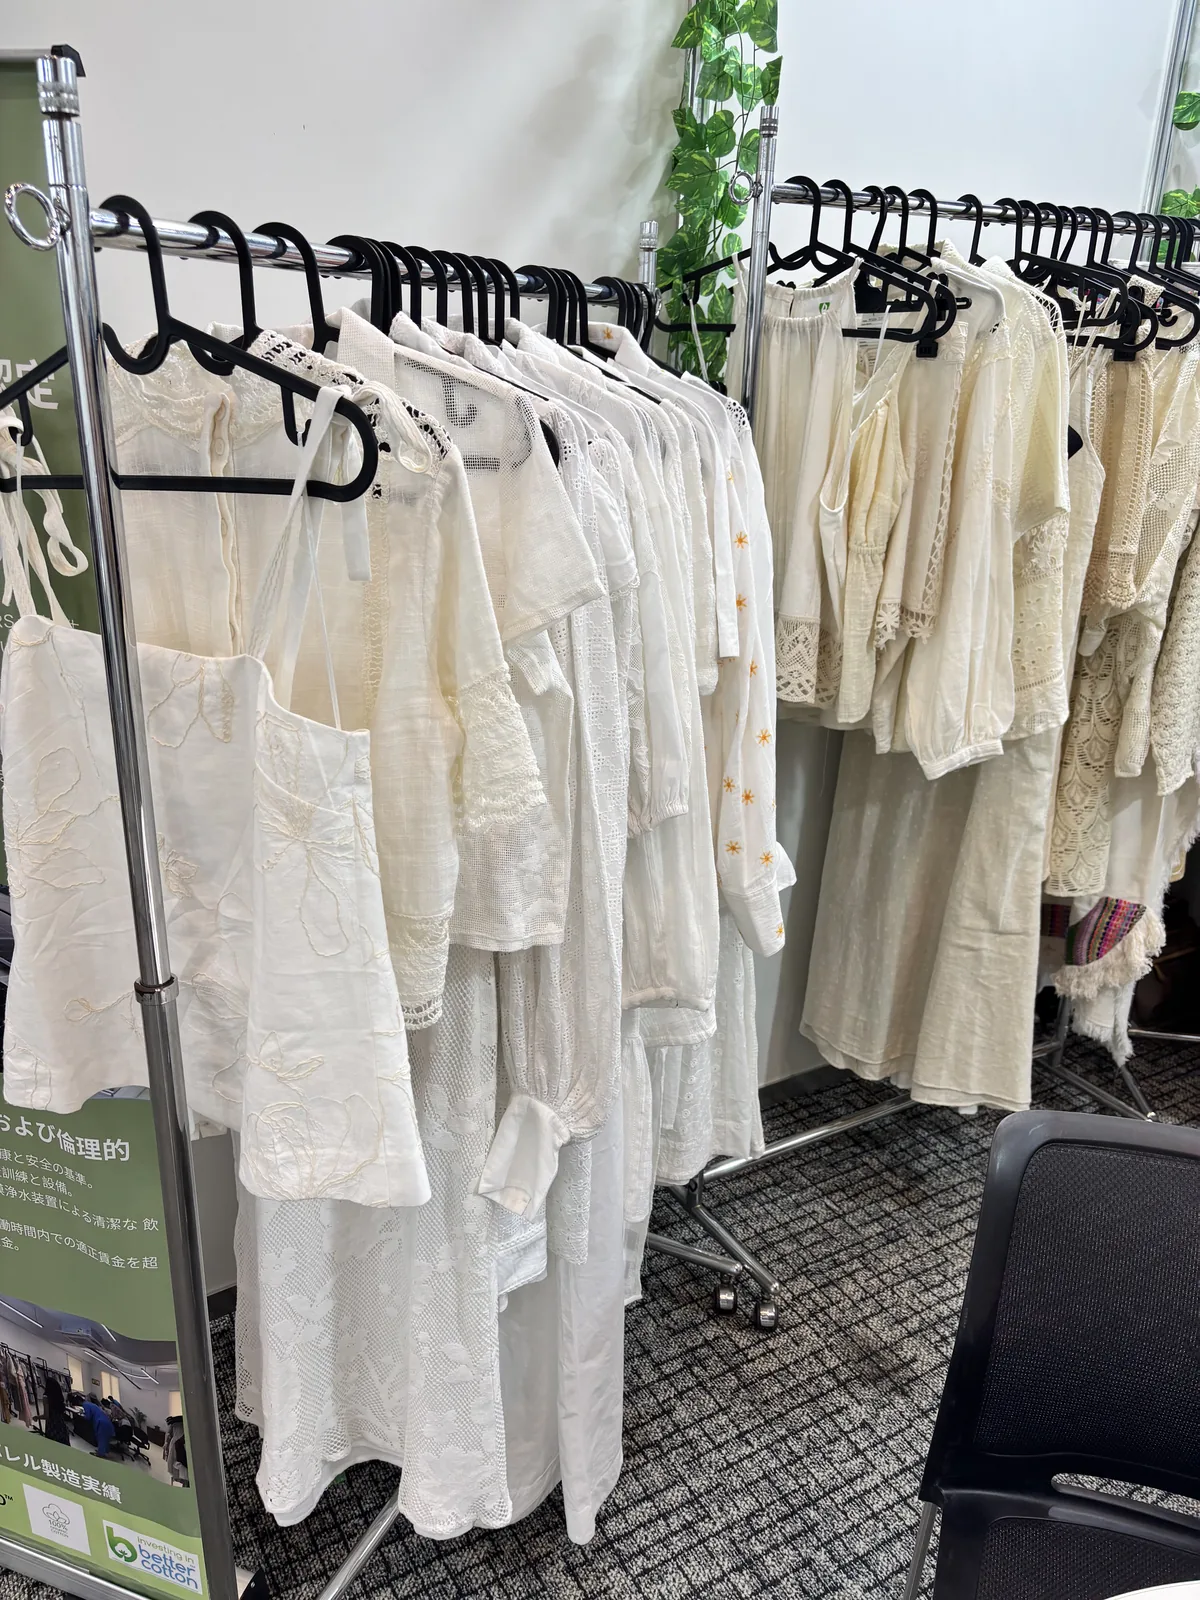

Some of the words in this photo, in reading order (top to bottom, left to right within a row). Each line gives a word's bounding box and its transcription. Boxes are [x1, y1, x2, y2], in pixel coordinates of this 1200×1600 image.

[0, 1166, 73, 1197] 訓練と設備。
[0, 1236, 20, 1251] 金。
[0, 1444, 122, 1504] レル製造実績
[138, 1543, 196, 1576] better
[141, 1559, 199, 1590] cotton
